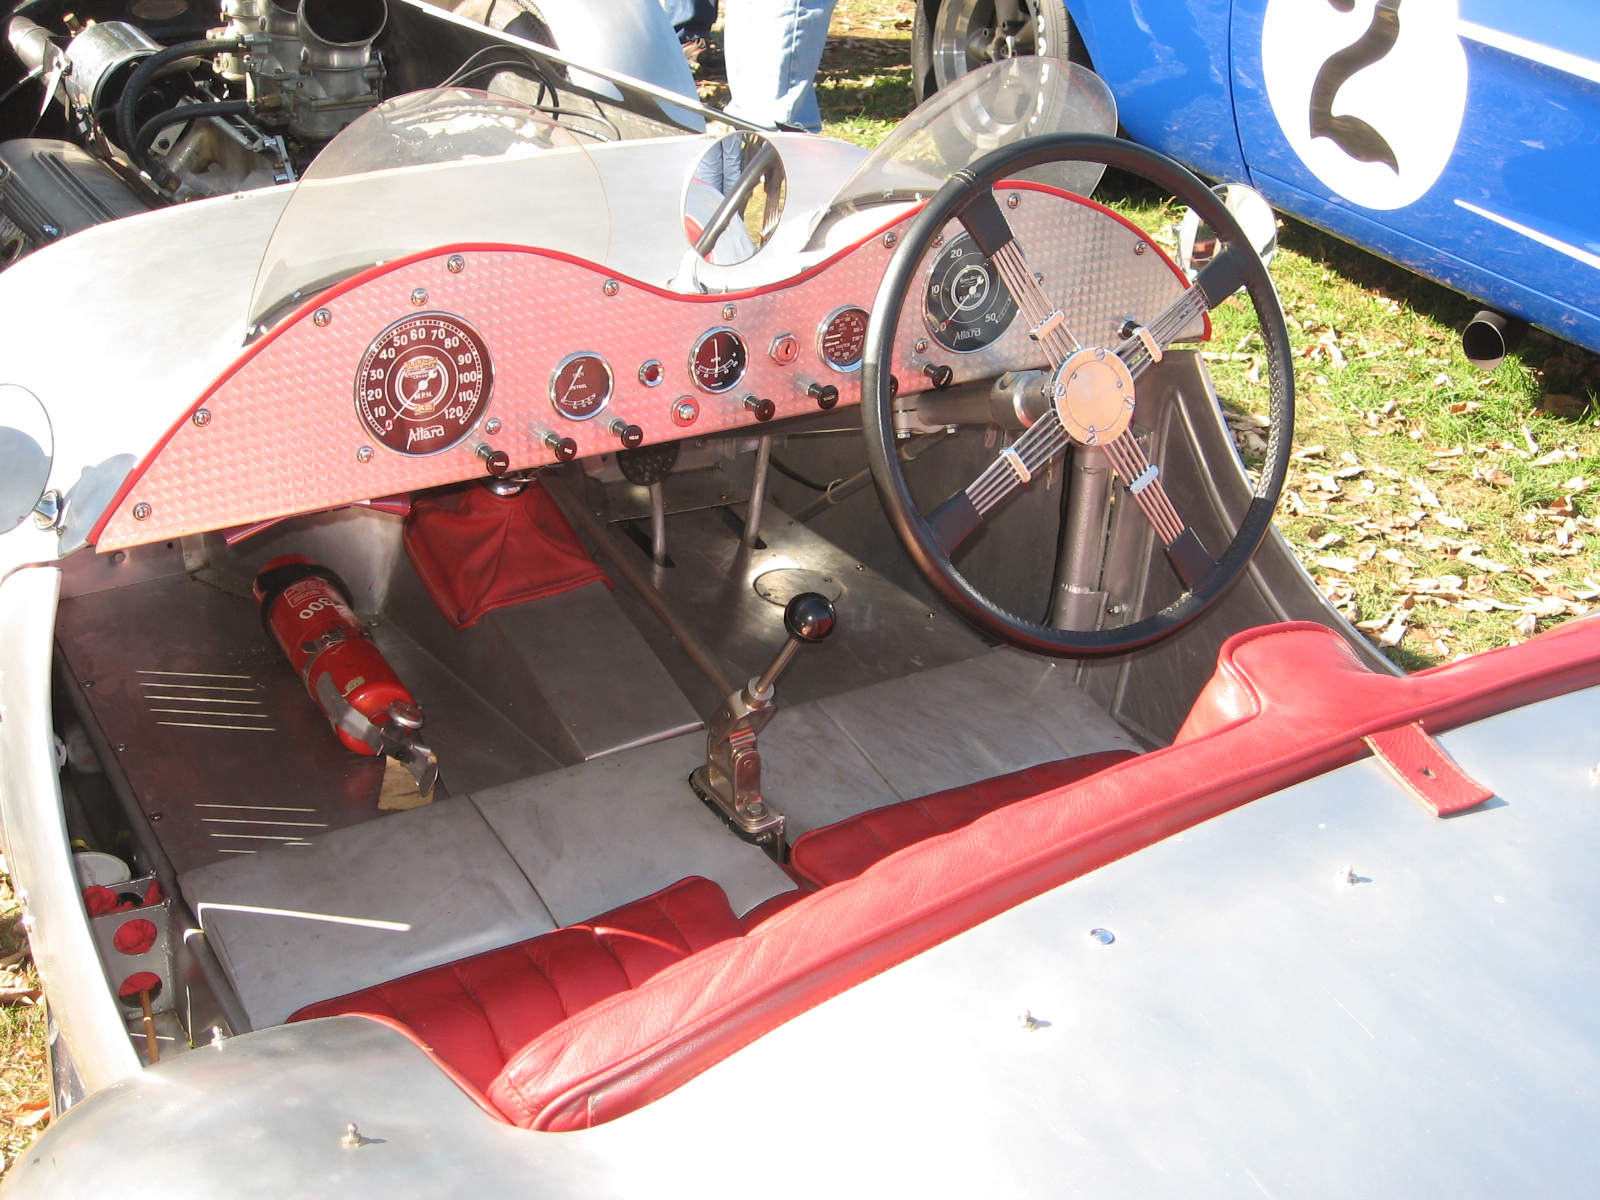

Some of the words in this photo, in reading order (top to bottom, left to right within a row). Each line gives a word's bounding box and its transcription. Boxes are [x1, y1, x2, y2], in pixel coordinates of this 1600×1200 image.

[1308, 0, 1401, 178] 2
[950, 248, 963, 259] 20
[931, 284, 940, 294] 10
[985, 312, 996, 323] 50
[940, 322, 947, 331] 0
[393, 334, 408, 347] 50
[410, 328, 426, 341] 60
[430, 328, 446, 341] 70
[952, 327, 981, 347] Allard
[444, 336, 460, 349] 80
[379, 347, 396, 360] 40
[457, 352, 472, 365] 90
[369, 368, 385, 381] 30
[459, 371, 477, 384] 100
[367, 388, 383, 401] 20
[458, 390, 474, 403] 110
[373, 405, 387, 418] 10
[444, 405, 464, 420] 120
[385, 419, 393, 431] 0
[406, 424, 445, 451] Allard
[299, 597, 331, 621] 300
